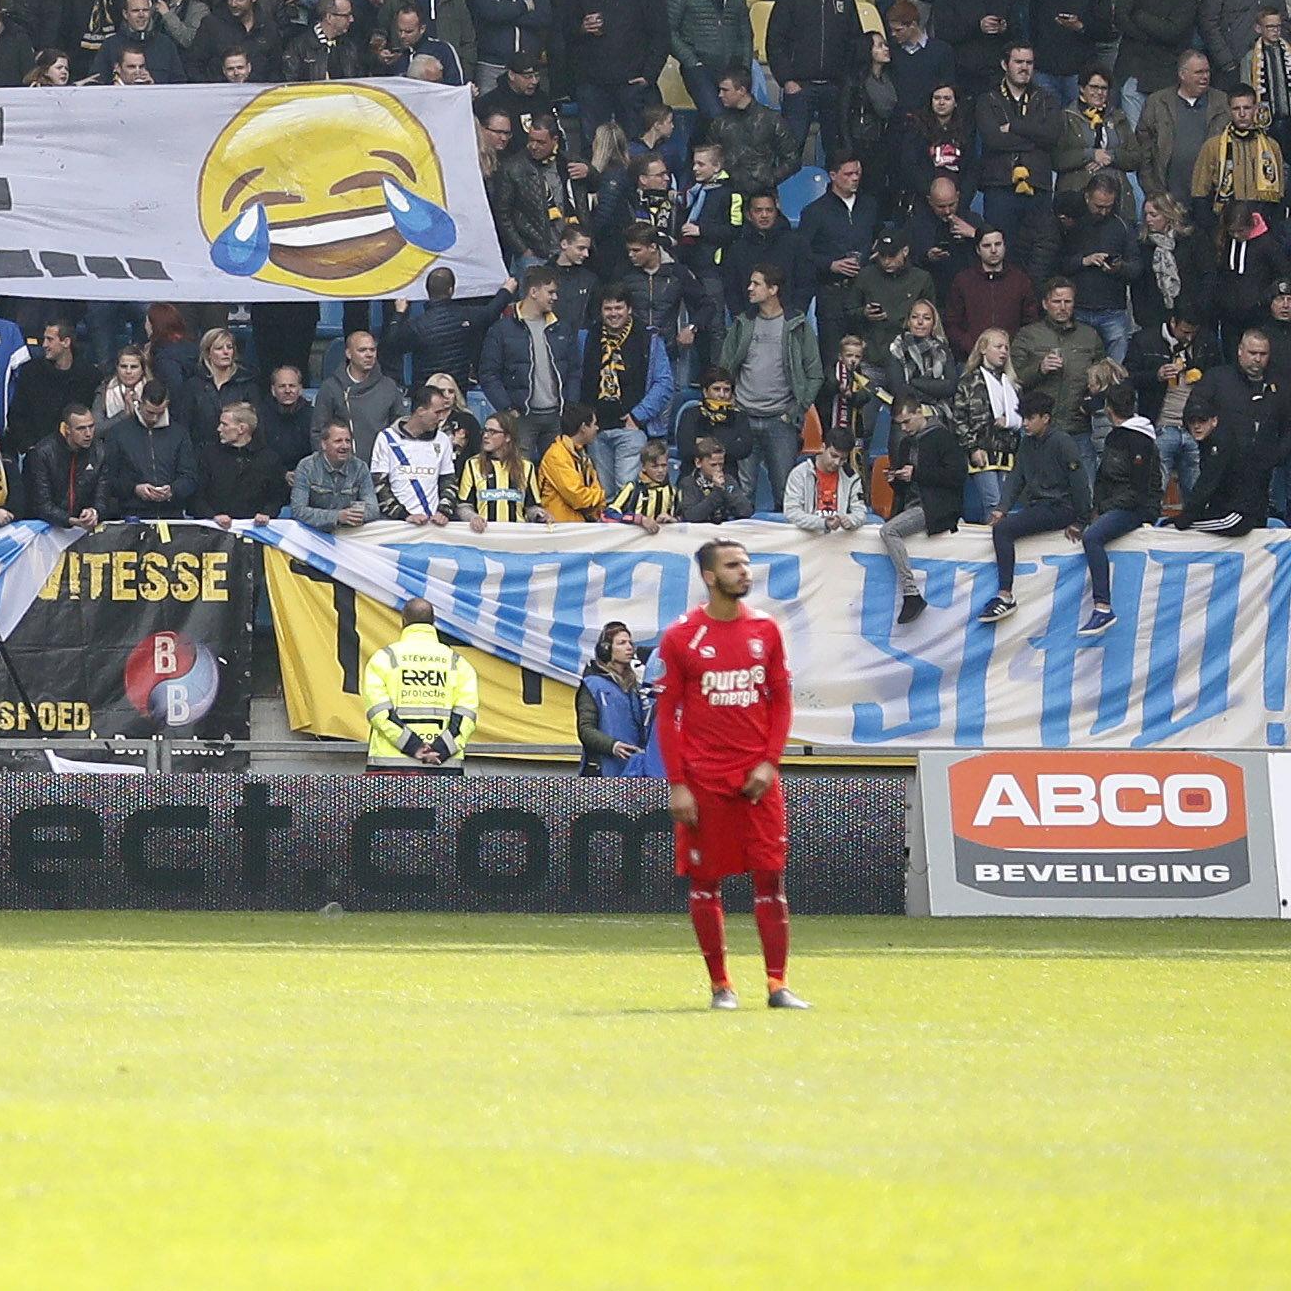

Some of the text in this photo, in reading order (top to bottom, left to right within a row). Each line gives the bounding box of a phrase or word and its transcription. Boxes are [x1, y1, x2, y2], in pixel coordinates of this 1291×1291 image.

[401, 653, 448, 664] STEWARD
[401, 668, 447, 688] ERREN
[700, 670, 749, 696] pure
[708, 690, 760, 708] energie
[973, 773, 1228, 827] ABCO
[975, 863, 1231, 884] BEVEILIGING
